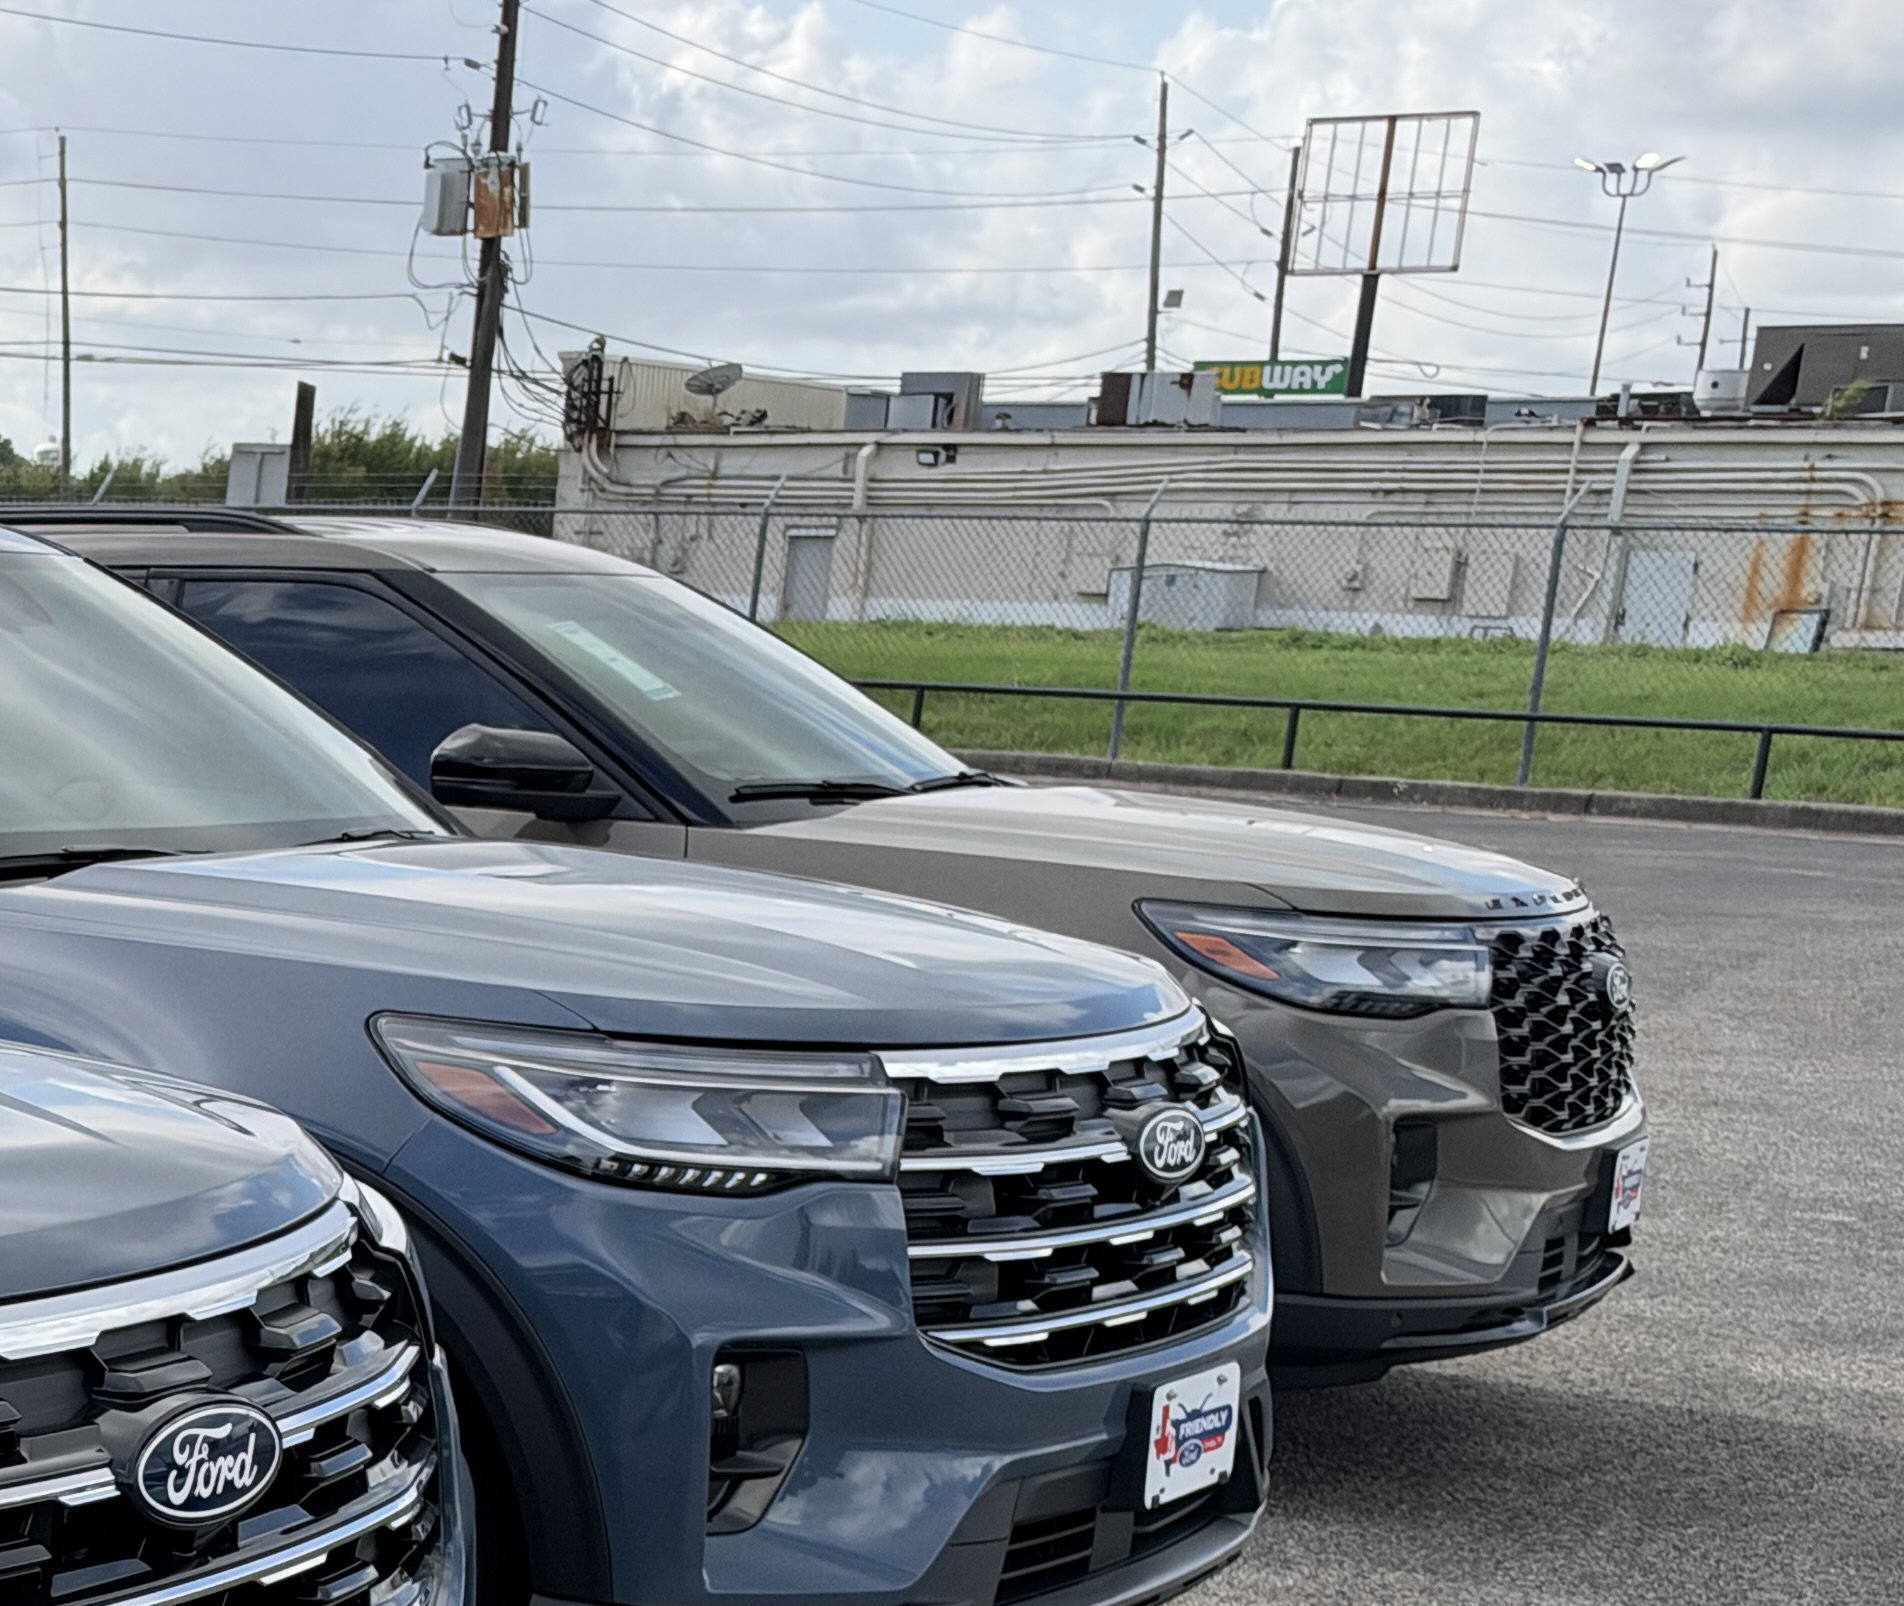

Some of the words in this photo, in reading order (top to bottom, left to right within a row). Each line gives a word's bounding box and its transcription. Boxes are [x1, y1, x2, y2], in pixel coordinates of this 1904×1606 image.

[1209, 363, 1344, 391] UBWAY
[1154, 1120, 1196, 1169] Ford
[1178, 1408, 1229, 1441] FRIENDLY
[167, 1422, 258, 1506] Ford
